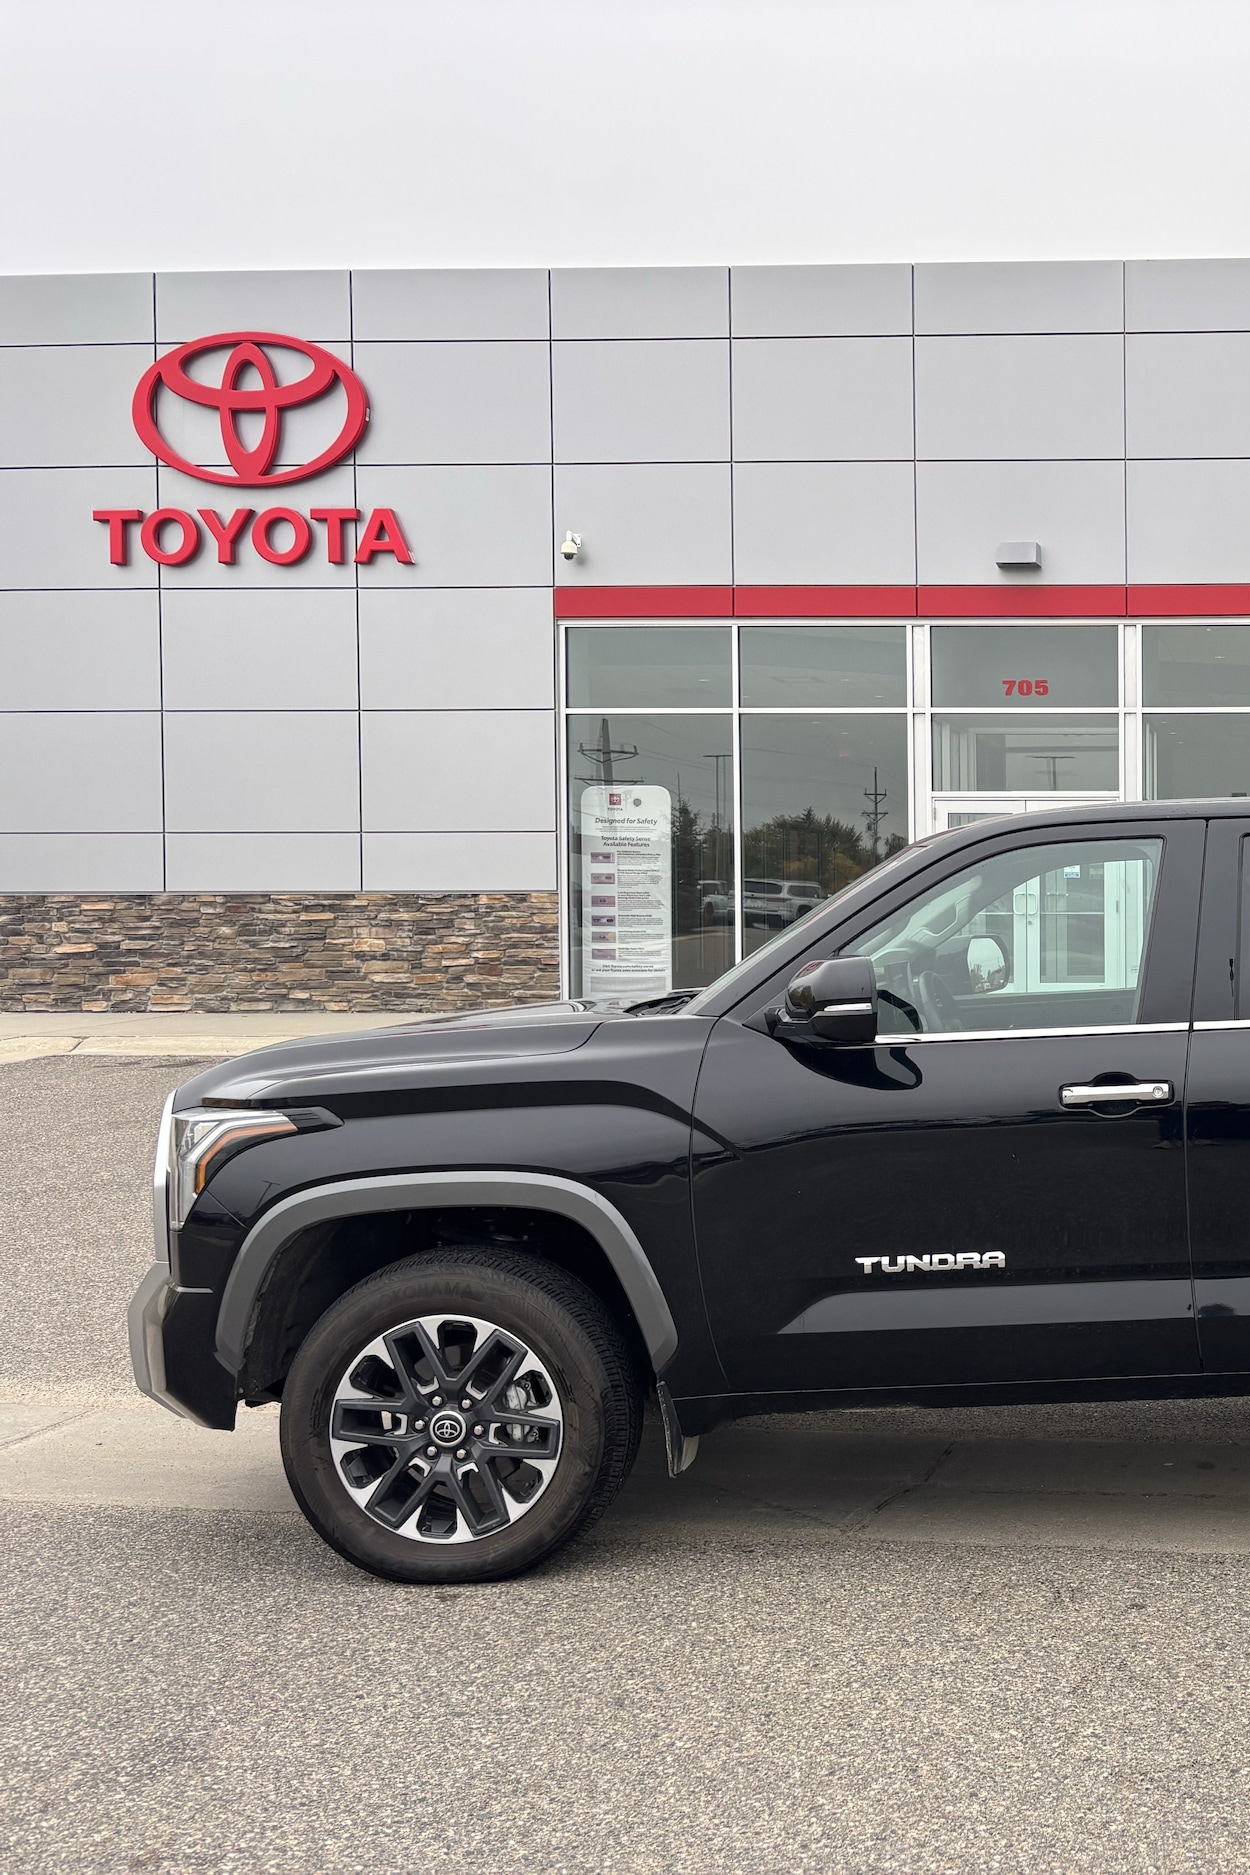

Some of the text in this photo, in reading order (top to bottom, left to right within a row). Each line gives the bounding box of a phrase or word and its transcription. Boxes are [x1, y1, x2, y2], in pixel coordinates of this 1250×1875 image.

[92, 506, 415, 566] TOYOTA
[1002, 679, 1049, 696] 705
[595, 817, 625, 825] Designed
[855, 1250, 1006, 1275] TUNDRA
[371, 1280, 473, 1307] OKOHAMA
